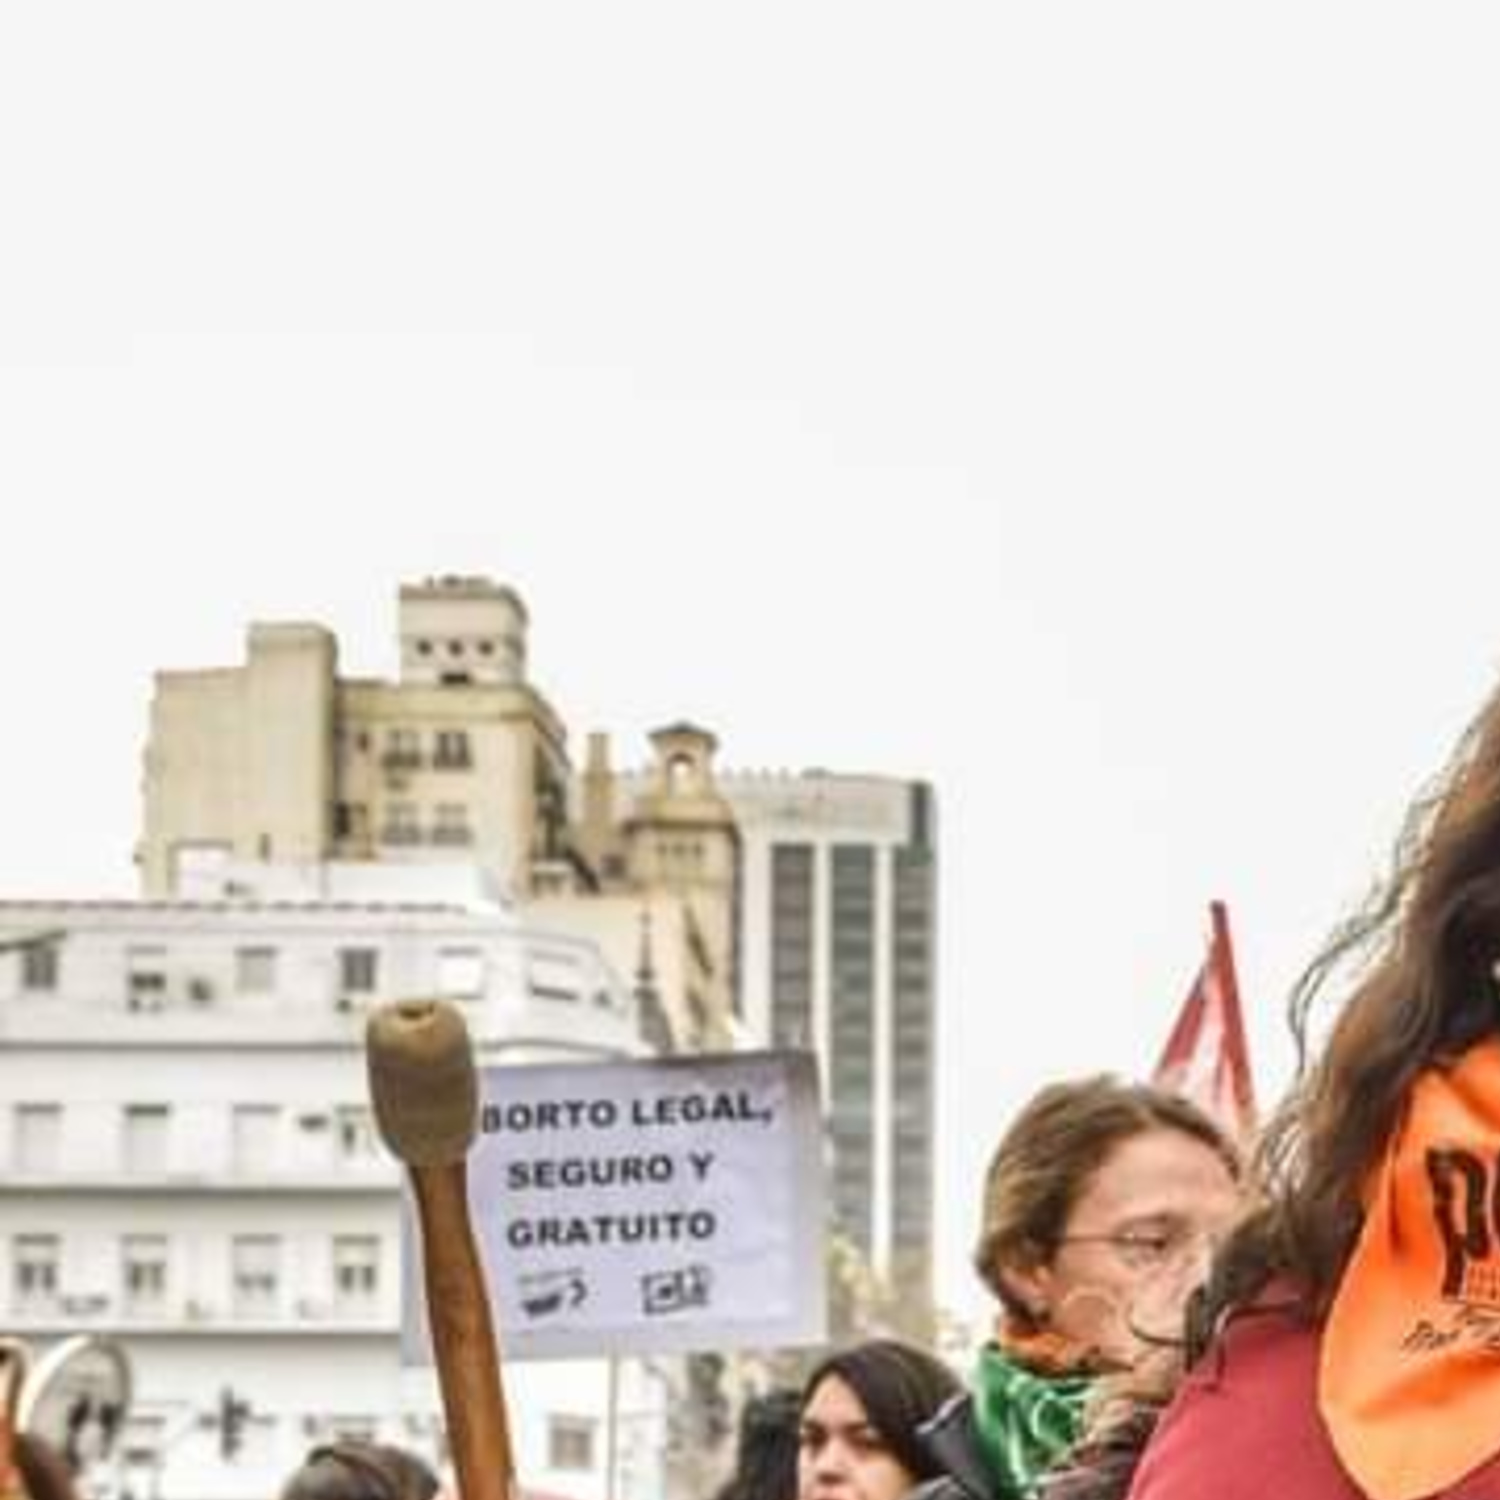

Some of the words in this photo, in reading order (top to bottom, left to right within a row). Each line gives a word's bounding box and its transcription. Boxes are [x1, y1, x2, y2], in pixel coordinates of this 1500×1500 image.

[483, 1099, 617, 1134] BORTO
[632, 1090, 774, 1127] LEGAL,
[507, 1154, 674, 1190] SEGURO
[688, 1151, 715, 1182] Y
[507, 1210, 717, 1250] GRATUITO
